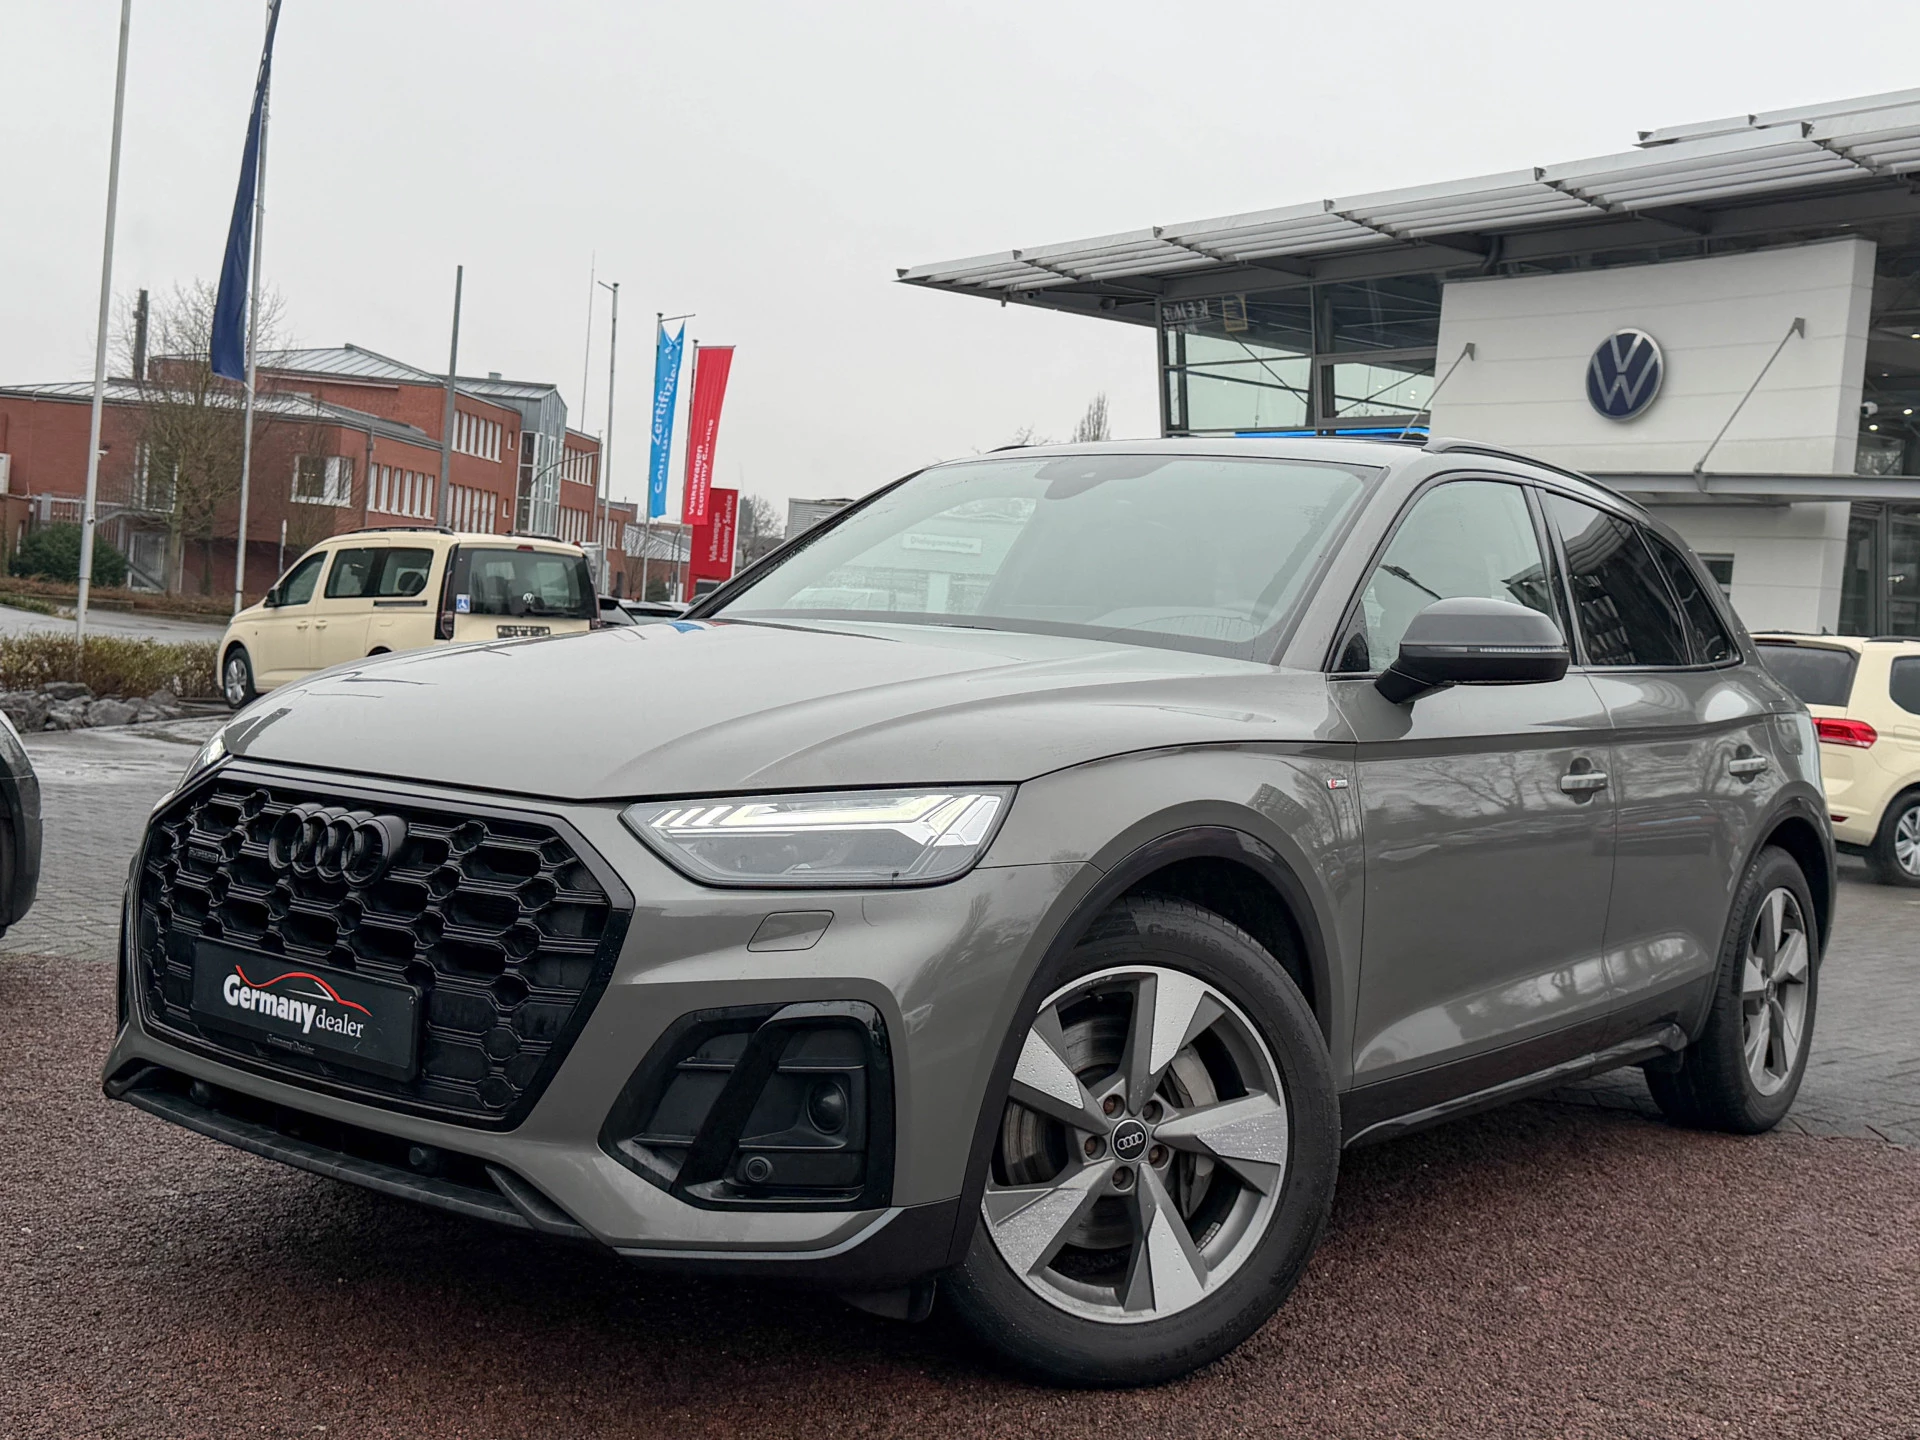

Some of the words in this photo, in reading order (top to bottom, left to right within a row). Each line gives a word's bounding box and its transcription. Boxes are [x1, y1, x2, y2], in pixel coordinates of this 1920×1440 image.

[689, 444, 703, 516] Volkswagen
[697, 463, 708, 516] Economy
[723, 495, 733, 524] Service
[709, 512, 721, 562] Volkswagen
[720, 525, 732, 563] Economy
[223, 974, 317, 1034] Germany
[316, 1008, 364, 1038] dealer
